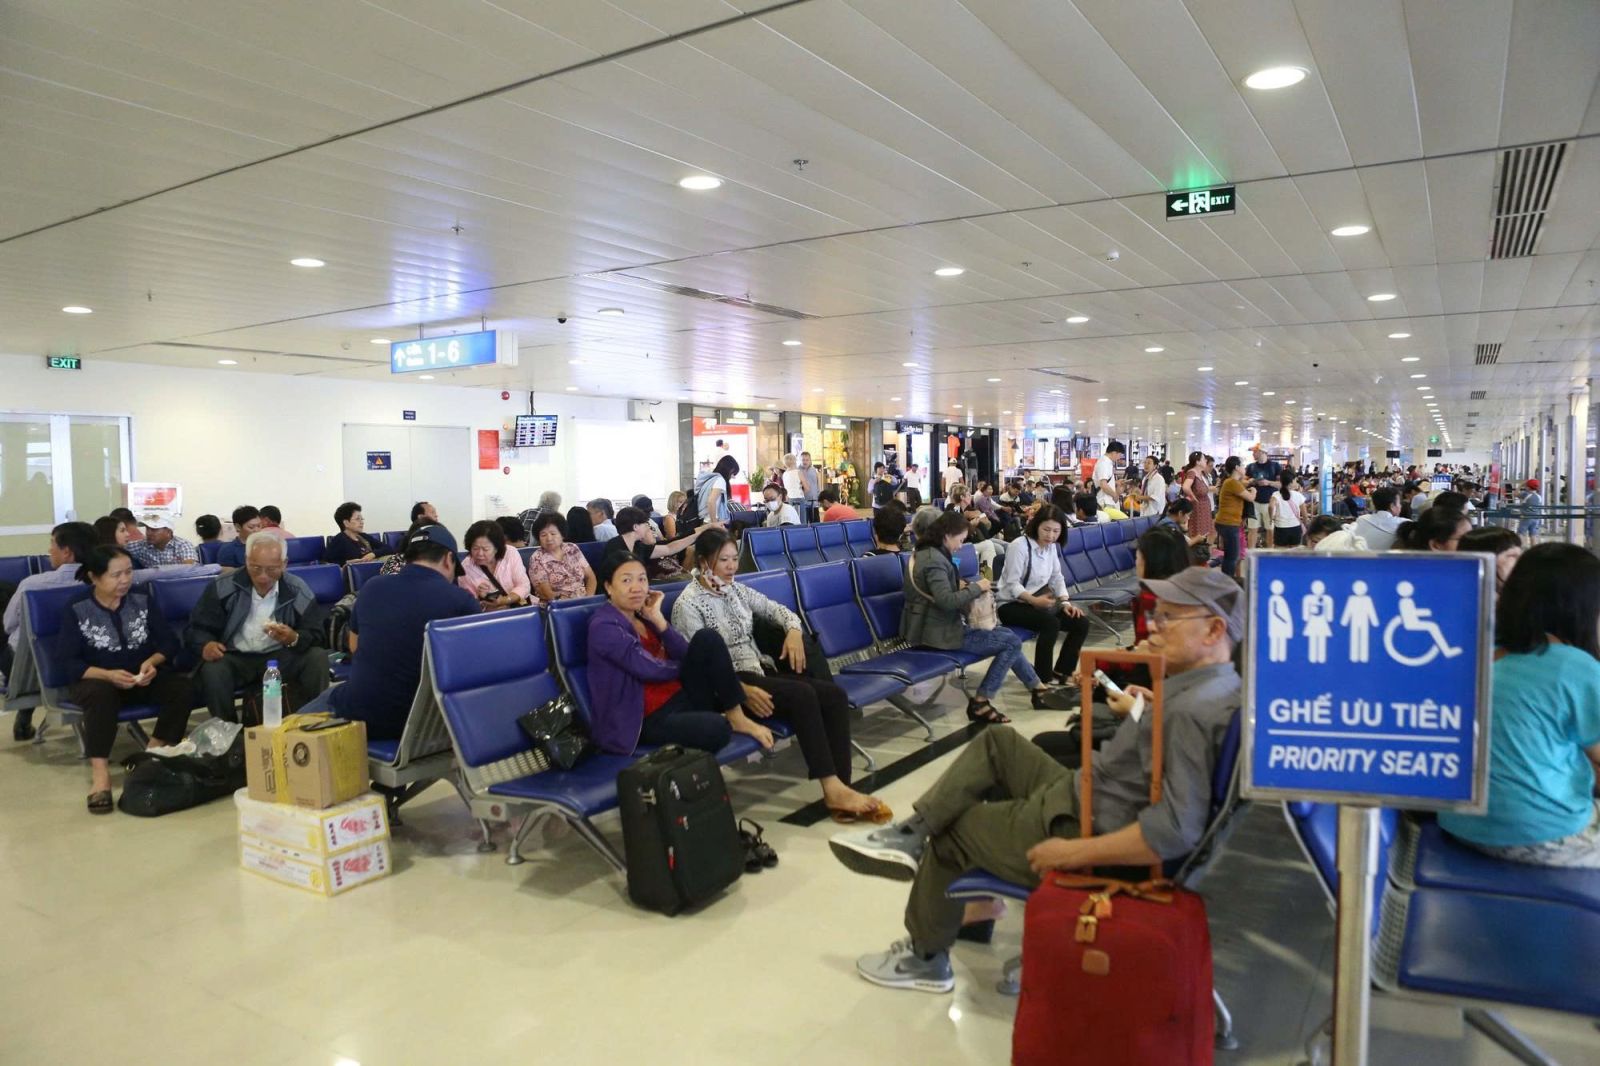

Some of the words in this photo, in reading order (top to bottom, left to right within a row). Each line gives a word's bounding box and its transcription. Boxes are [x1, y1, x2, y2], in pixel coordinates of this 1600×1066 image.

[1210, 195, 1230, 205] EXIT
[51, 357, 78, 368] EXIT
[1269, 692, 1332, 724] GHẾ
[1341, 698, 1383, 727] ƯU
[1391, 698, 1462, 730] TIÊN
[1269, 745, 1376, 773] PRIORITY
[1380, 749, 1460, 778] SEATS
